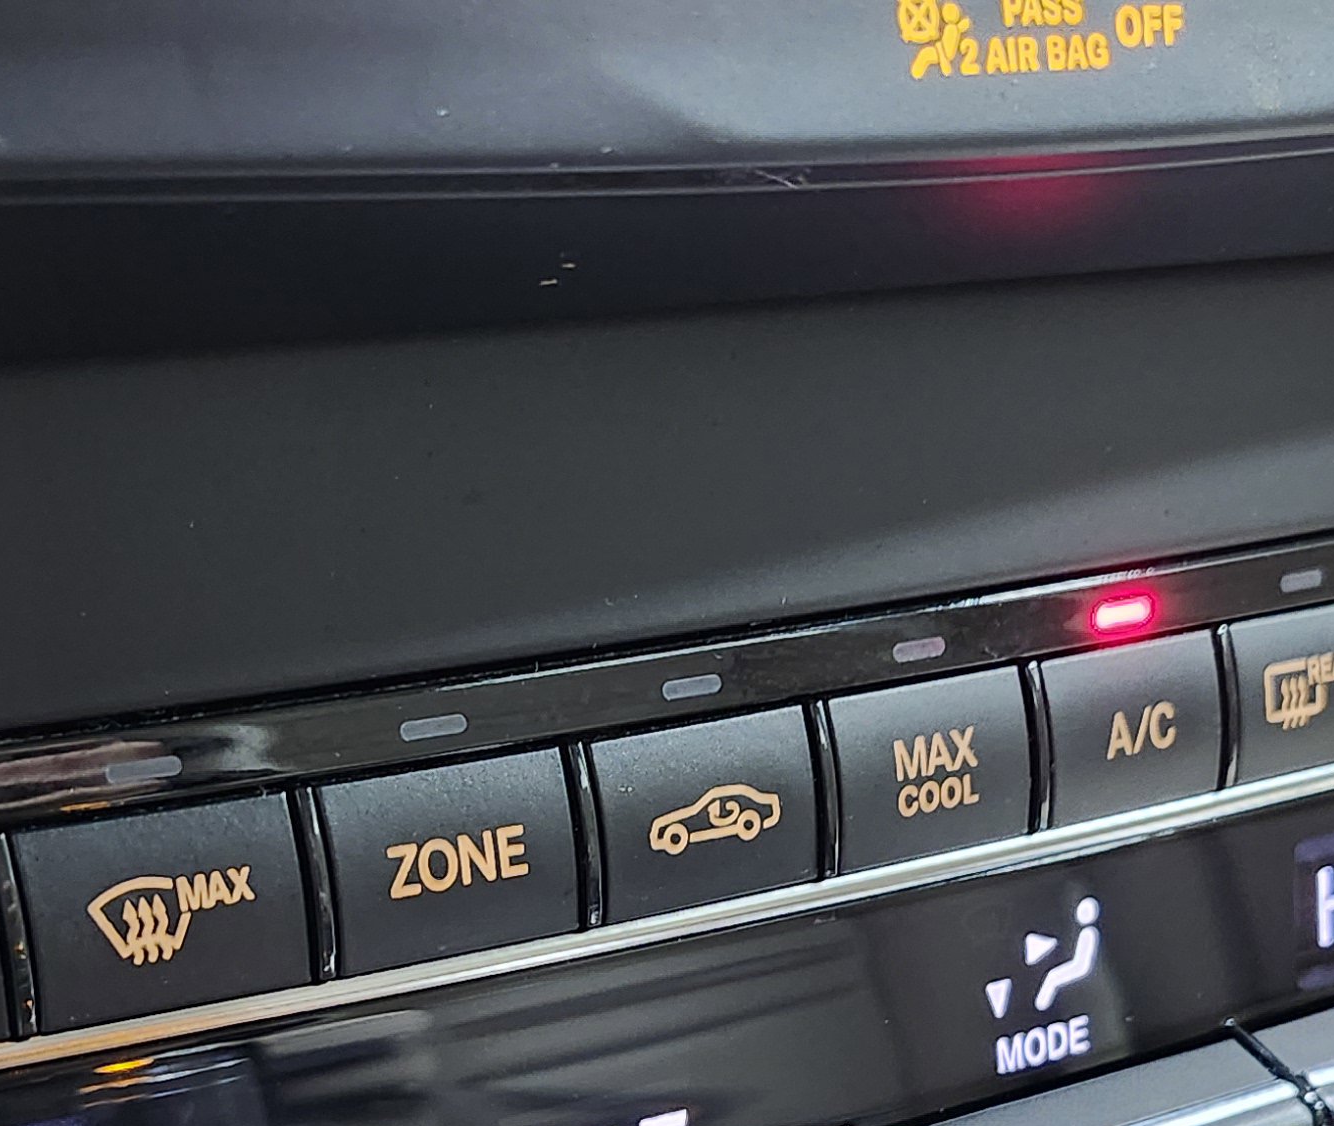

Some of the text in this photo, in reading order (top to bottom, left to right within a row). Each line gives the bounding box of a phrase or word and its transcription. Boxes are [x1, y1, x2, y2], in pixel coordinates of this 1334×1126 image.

[1002, 0, 1085, 27] PASS
[1115, 4, 1185, 48] OFF
[959, 33, 1110, 75] 2 AIR BAG
[893, 726, 979, 782] MAX
[1106, 700, 1177, 760] A/C
[897, 773, 980, 818] COOL
[386, 824, 530, 899] ZONE
[175, 866, 256, 914] MAX
[996, 1014, 1090, 1075] MODE
